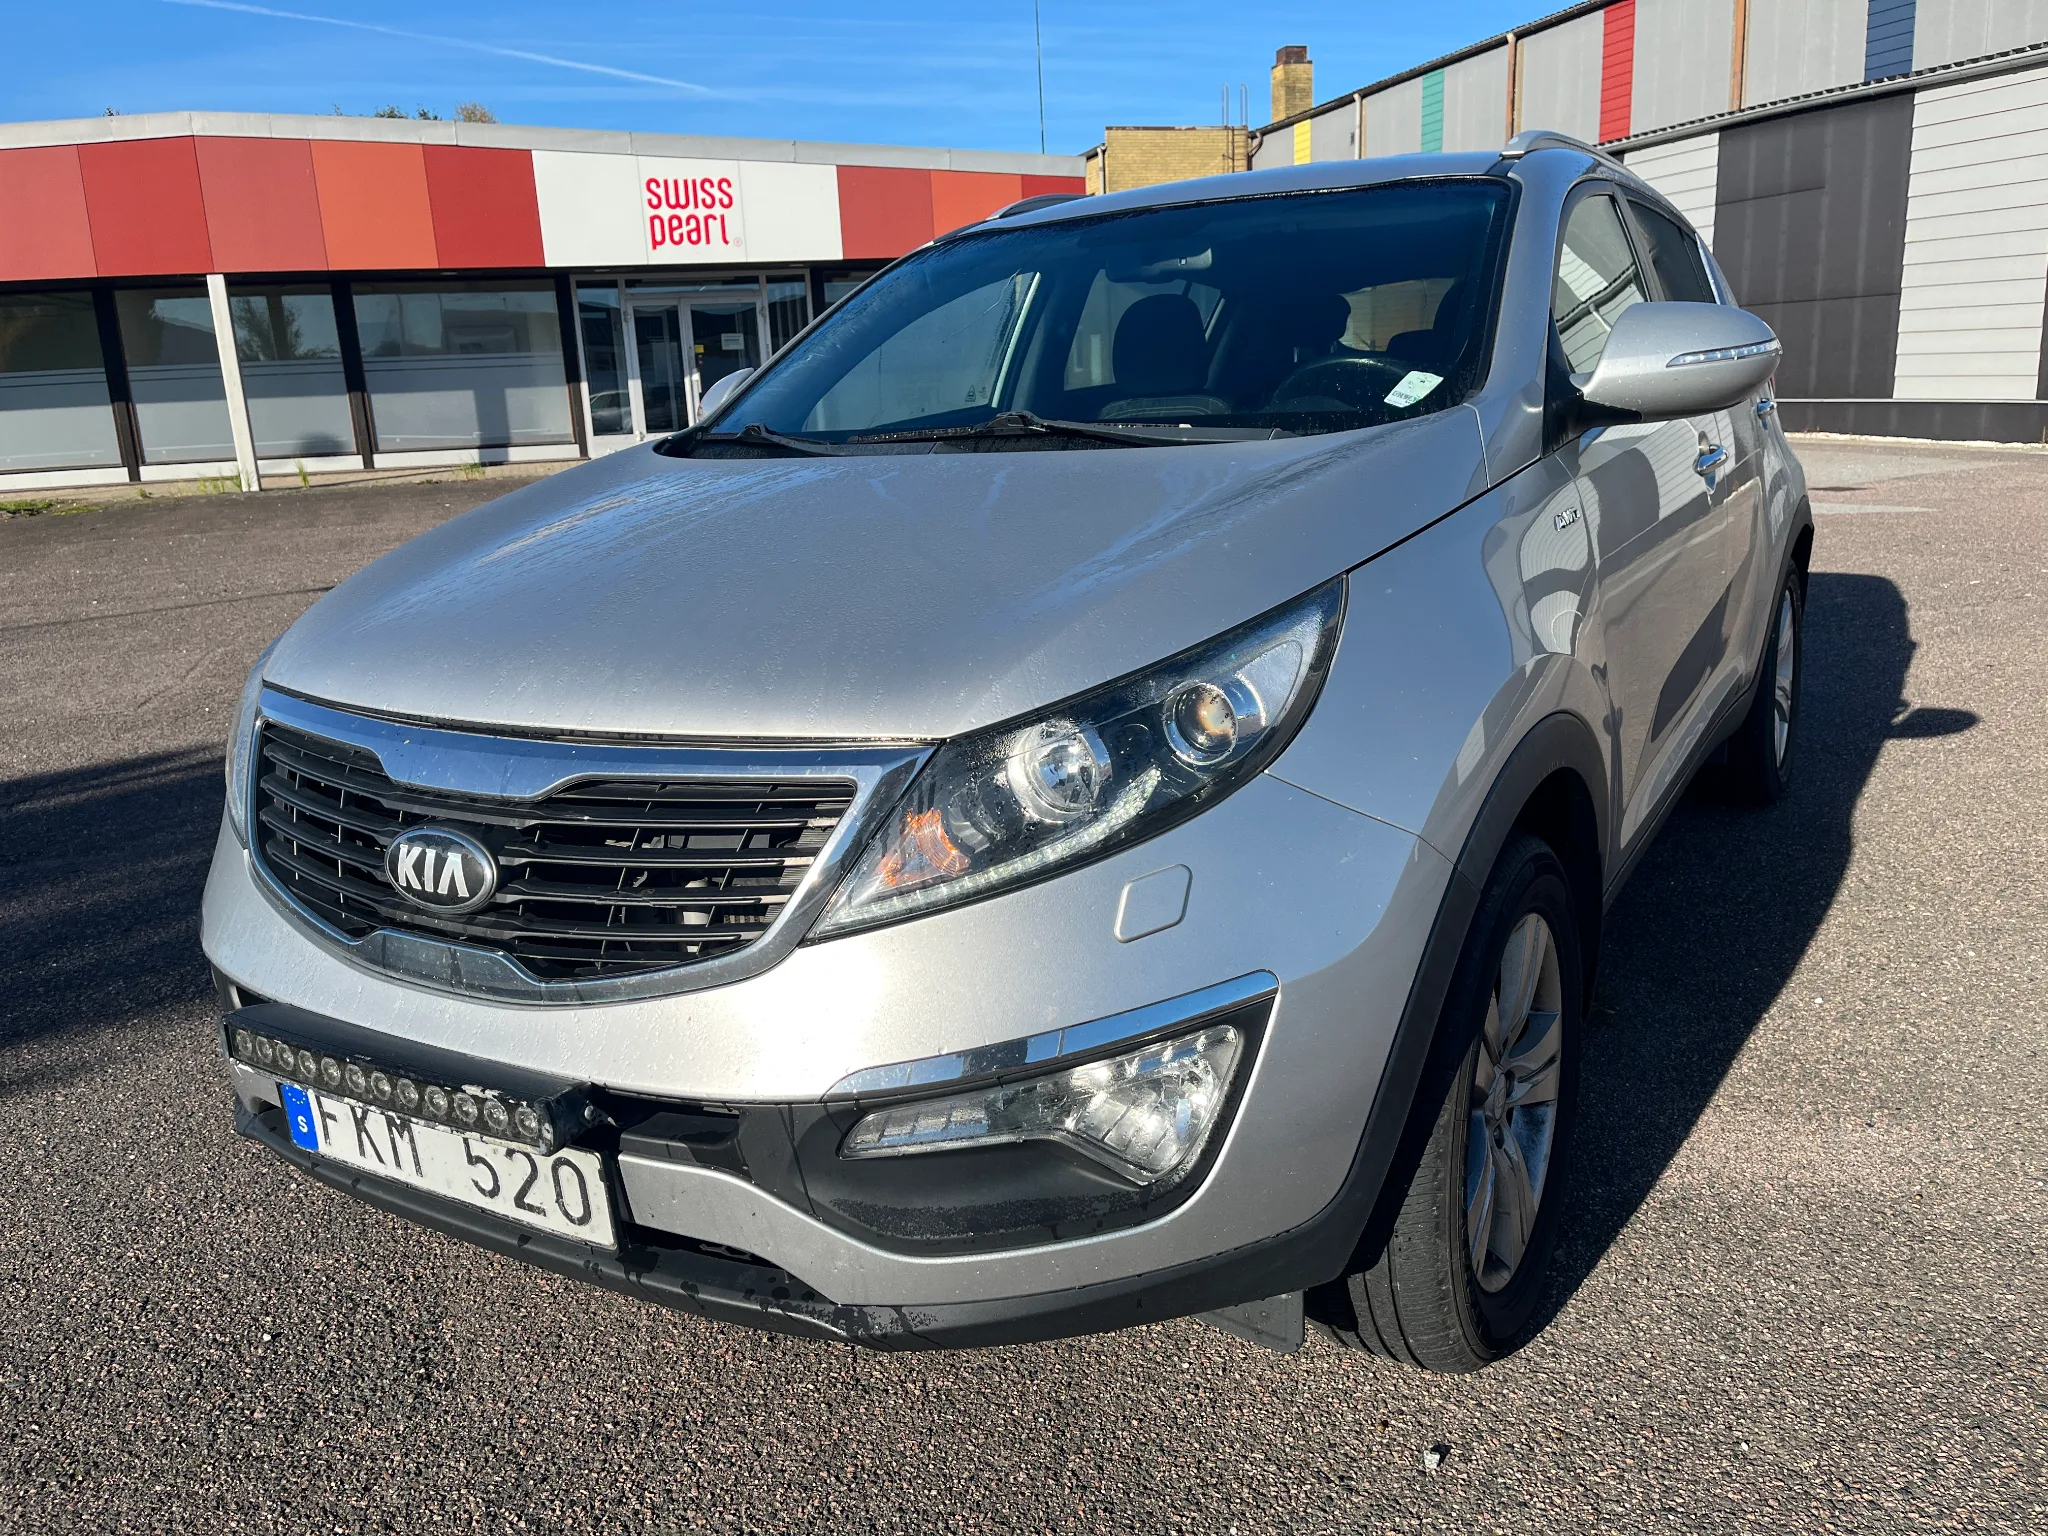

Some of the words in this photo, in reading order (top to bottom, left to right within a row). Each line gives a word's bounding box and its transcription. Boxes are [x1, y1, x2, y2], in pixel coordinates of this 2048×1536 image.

[649, 213, 730, 250] pearl
[398, 844, 470, 898] KIA
[297, 1115, 309, 1133] S
[314, 1094, 424, 1177] FKM
[462, 1137, 592, 1226] 520
